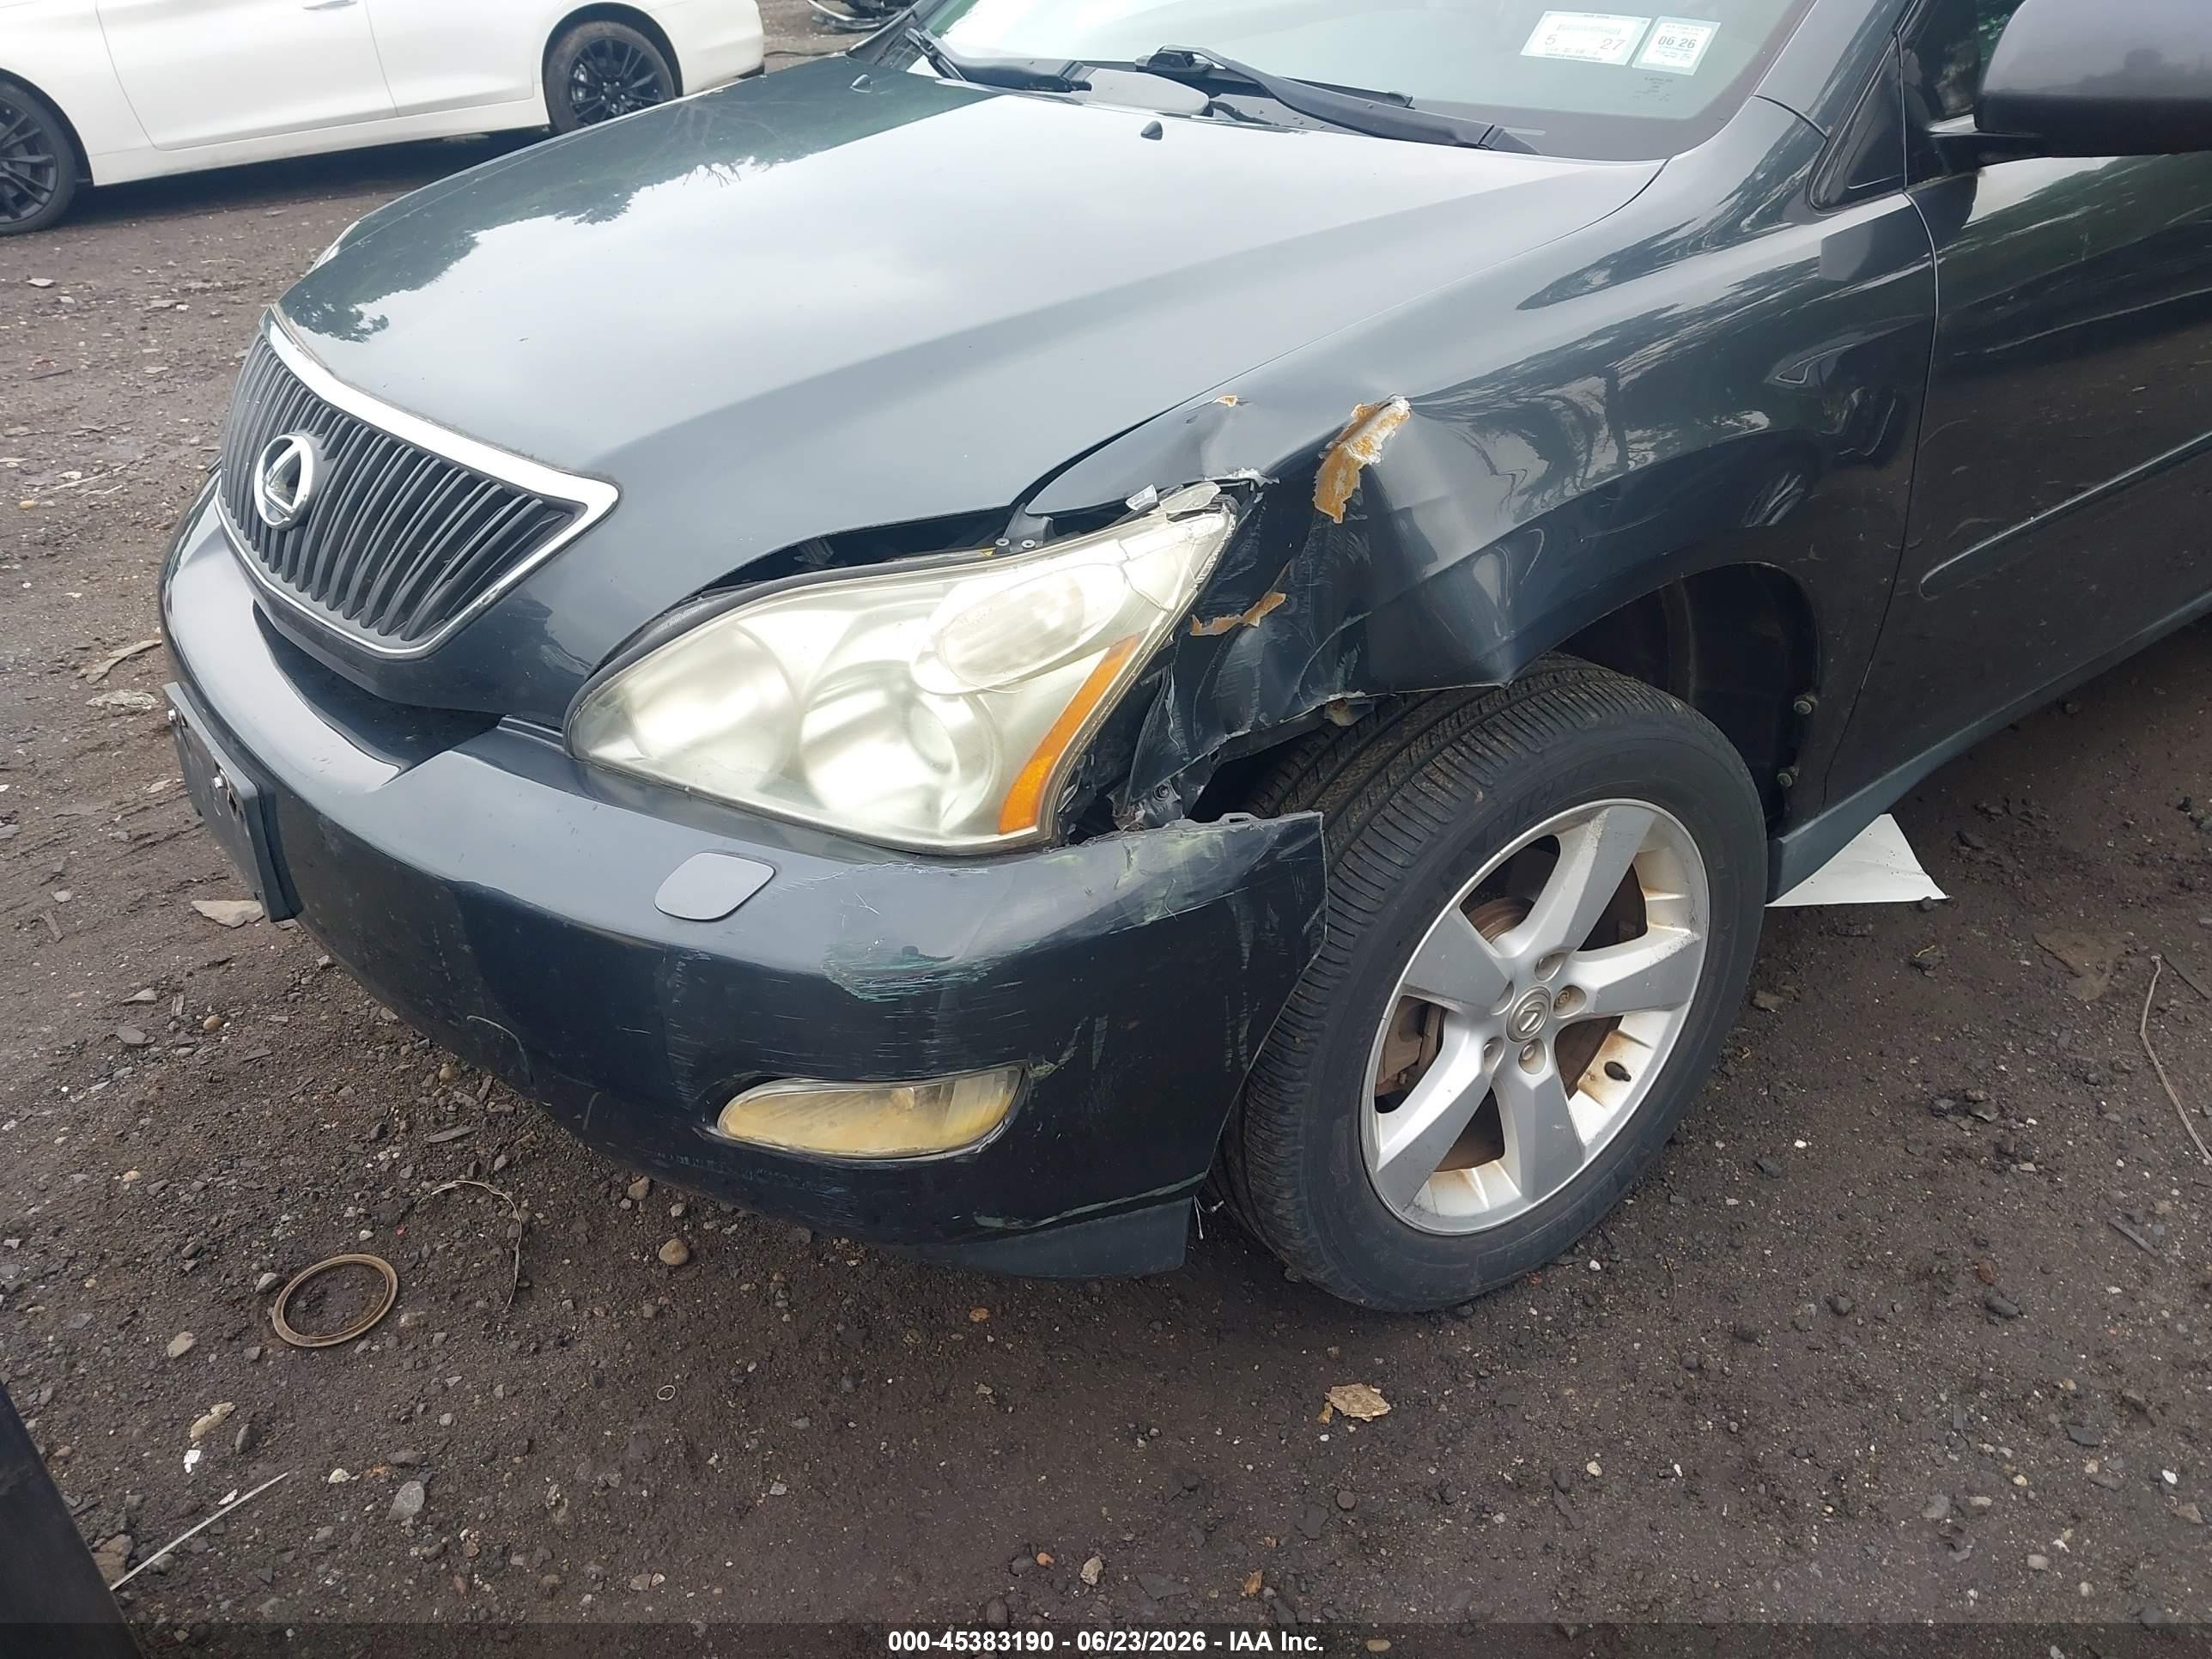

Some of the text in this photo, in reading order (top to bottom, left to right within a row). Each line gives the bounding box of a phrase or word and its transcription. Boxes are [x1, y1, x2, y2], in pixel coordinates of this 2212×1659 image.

[1600, 37, 1627, 51] 27
[1657, 35, 1676, 46] 06
[1678, 38, 1698, 49] 26
